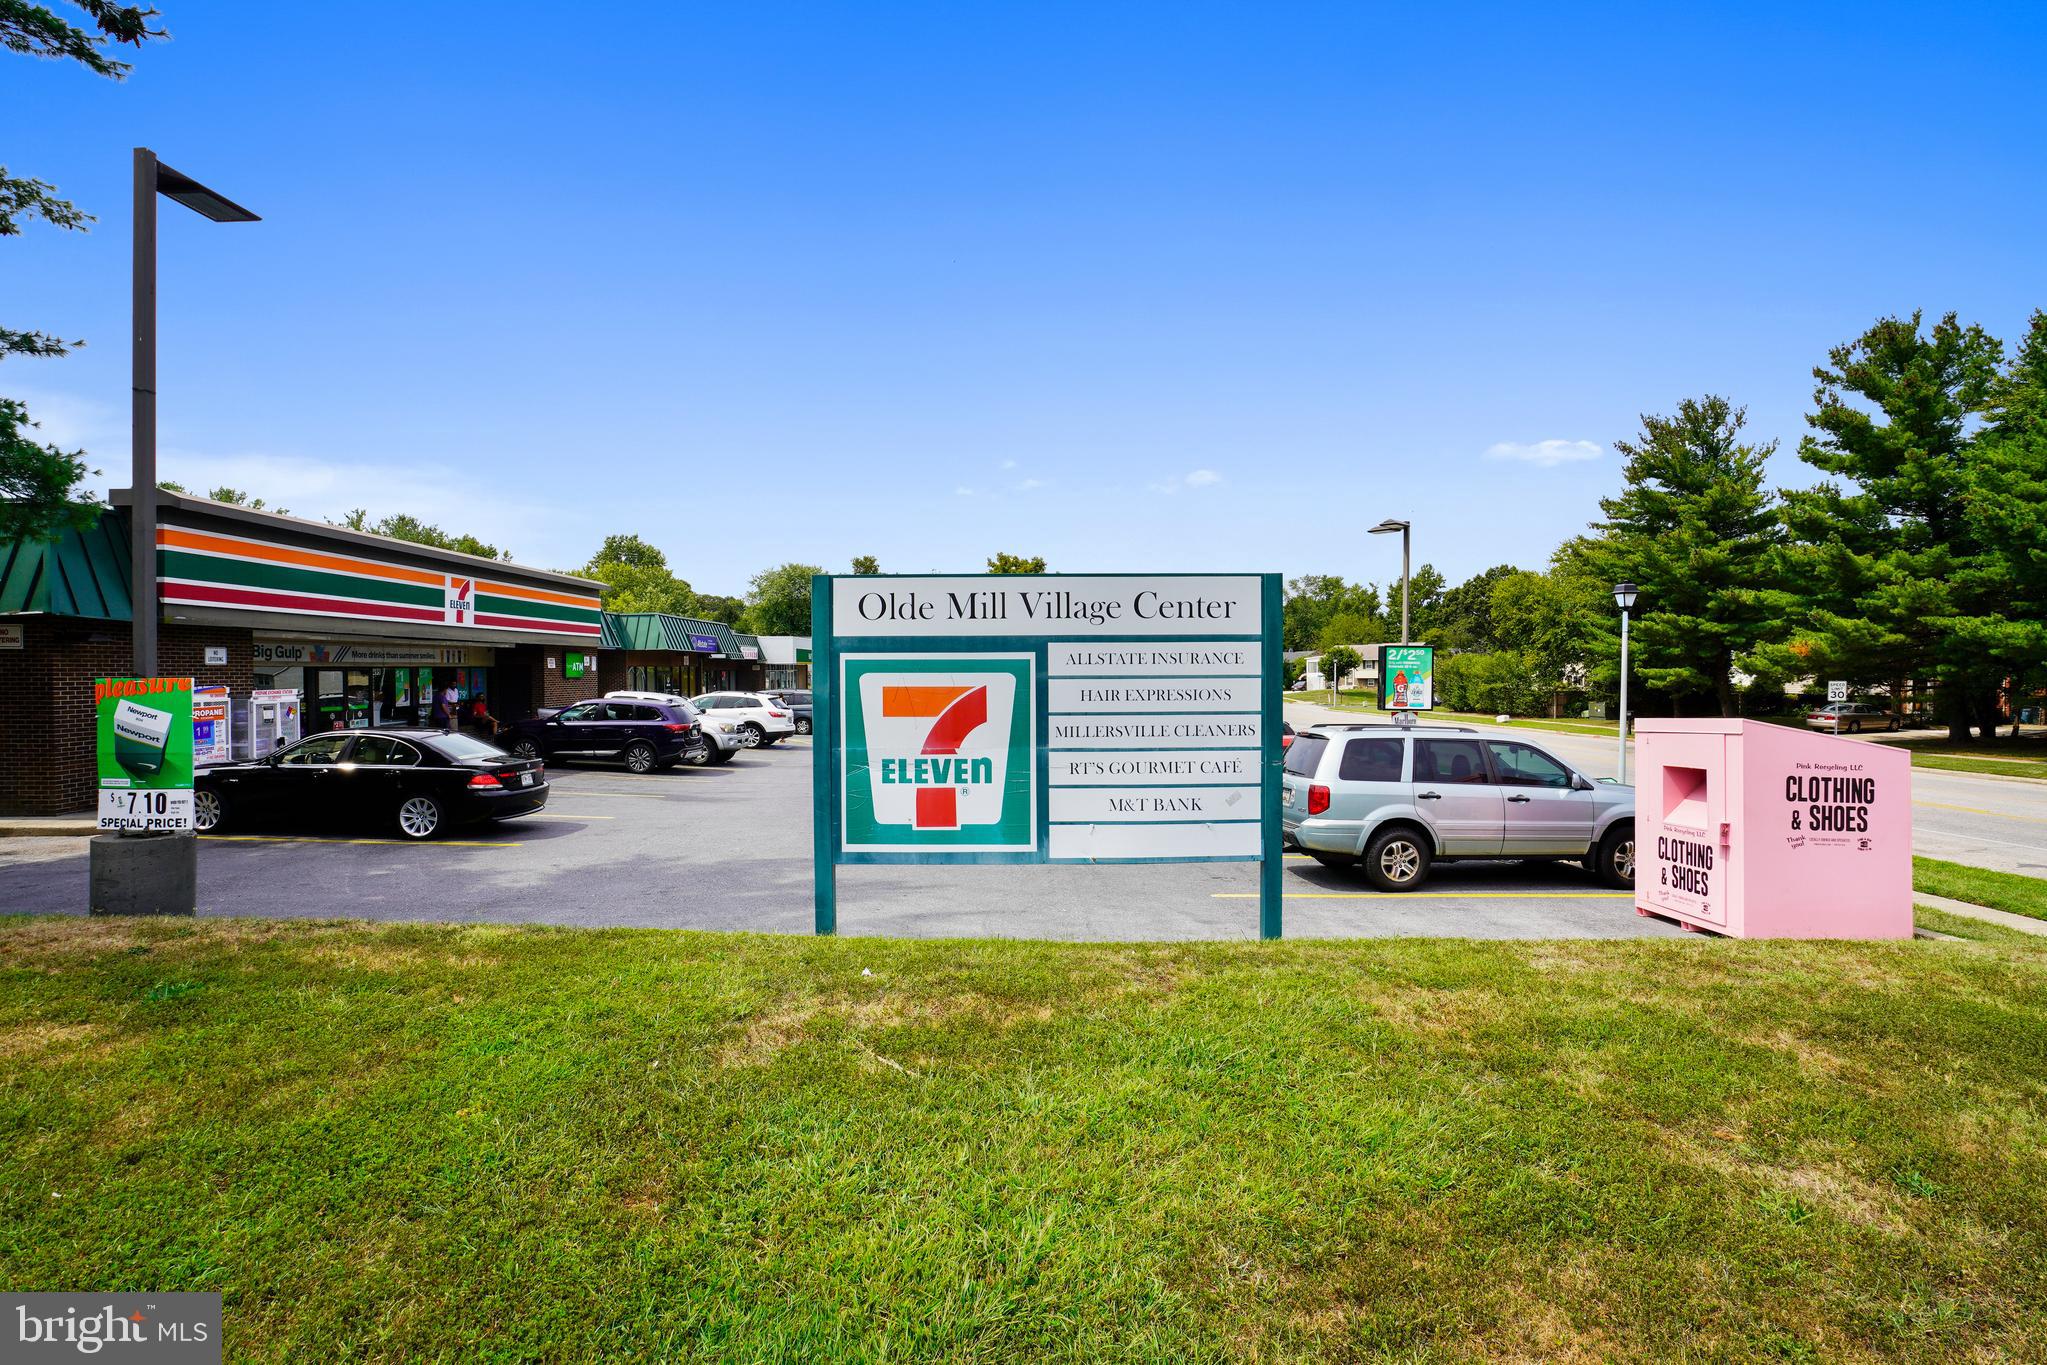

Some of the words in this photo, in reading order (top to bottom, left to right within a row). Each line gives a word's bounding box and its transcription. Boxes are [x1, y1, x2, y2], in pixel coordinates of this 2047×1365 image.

[451, 577, 470, 623] 7
[859, 592, 934, 621] Olde
[947, 592, 1007, 620] Mill
[1019, 592, 1122, 625] Village
[1133, 592, 1237, 620] Center
[253, 644, 272, 661] Big
[275, 645, 302, 661] Gulp
[352, 651, 367, 659] More
[368, 651, 385, 659] drinks
[1066, 652, 1148, 665] ALLSTATE
[1151, 652, 1244, 665] INSURANCE
[572, 662, 584, 671] ATM
[95, 678, 192, 705] pleasure
[1080, 689, 1121, 702] HAIR
[1125, 689, 1232, 702] EXPRESSIONS
[127, 706, 158, 721] Newport
[116, 723, 161, 744] Newport
[1055, 725, 1170, 738] MILLERSVILLE
[1173, 724, 1256, 737] CLEANERS
[883, 685, 987, 827] 7
[1108, 761, 1196, 774] GOURMET
[1200, 757, 1243, 774] CAFÉ
[1814, 763, 1848, 772] Recycling
[1786, 775, 1875, 804] CLOTHING
[1109, 798, 1149, 812] M&T
[1153, 797, 1203, 812] BANK
[101, 817, 144, 828] SPECIAL
[146, 817, 188, 828] PRICE!
[1791, 810, 1802, 830] &
[1809, 804, 1868, 833] SHOES
[1786, 834, 1806, 843] Thank
[1658, 836, 1713, 871] CLOTHING
[1661, 867, 1668, 885] &
[1672, 864, 1709, 897] SHOES
